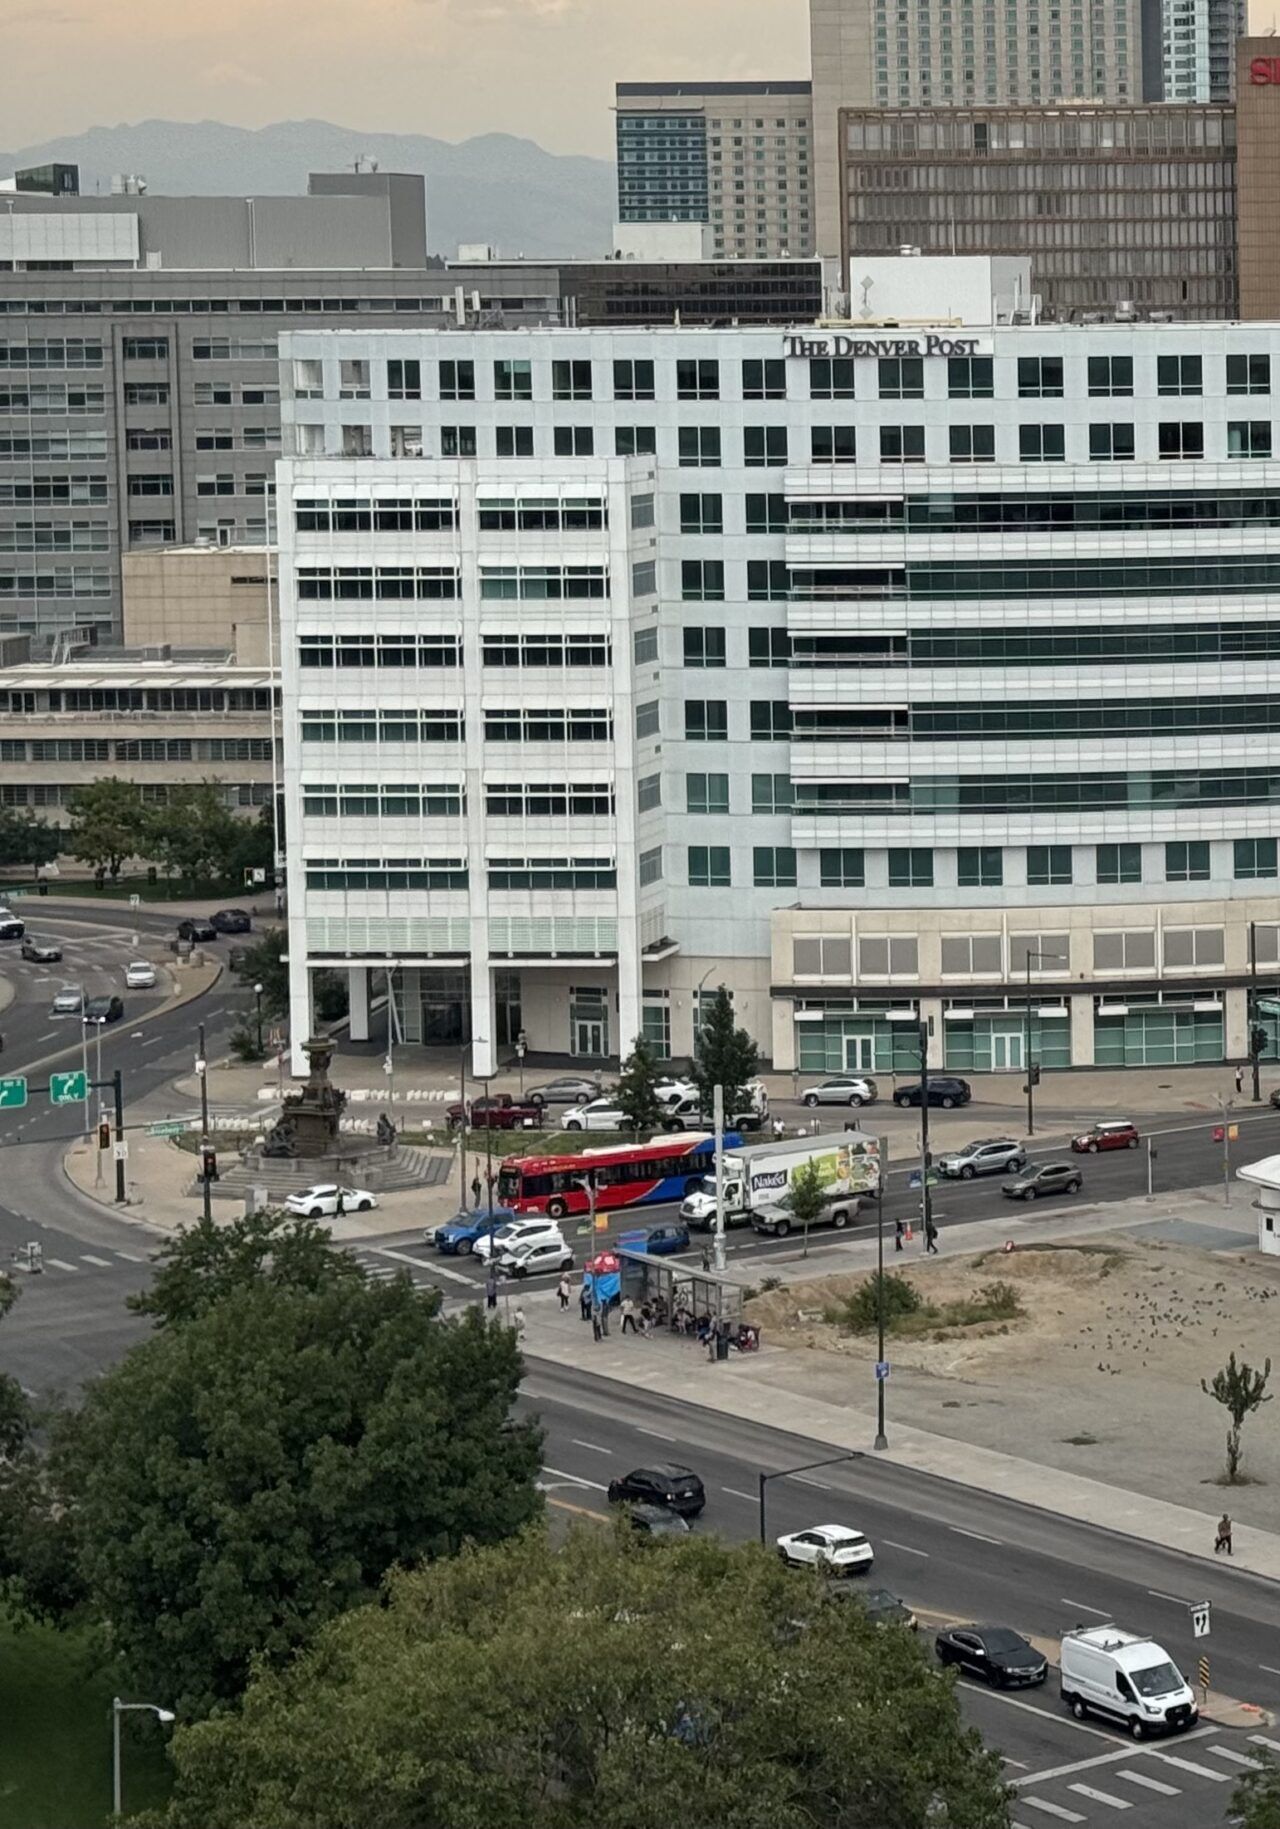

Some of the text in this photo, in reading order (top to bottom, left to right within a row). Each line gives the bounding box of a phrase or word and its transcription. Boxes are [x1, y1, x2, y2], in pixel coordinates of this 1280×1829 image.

[784, 335, 979, 358] THE DENVER POST
